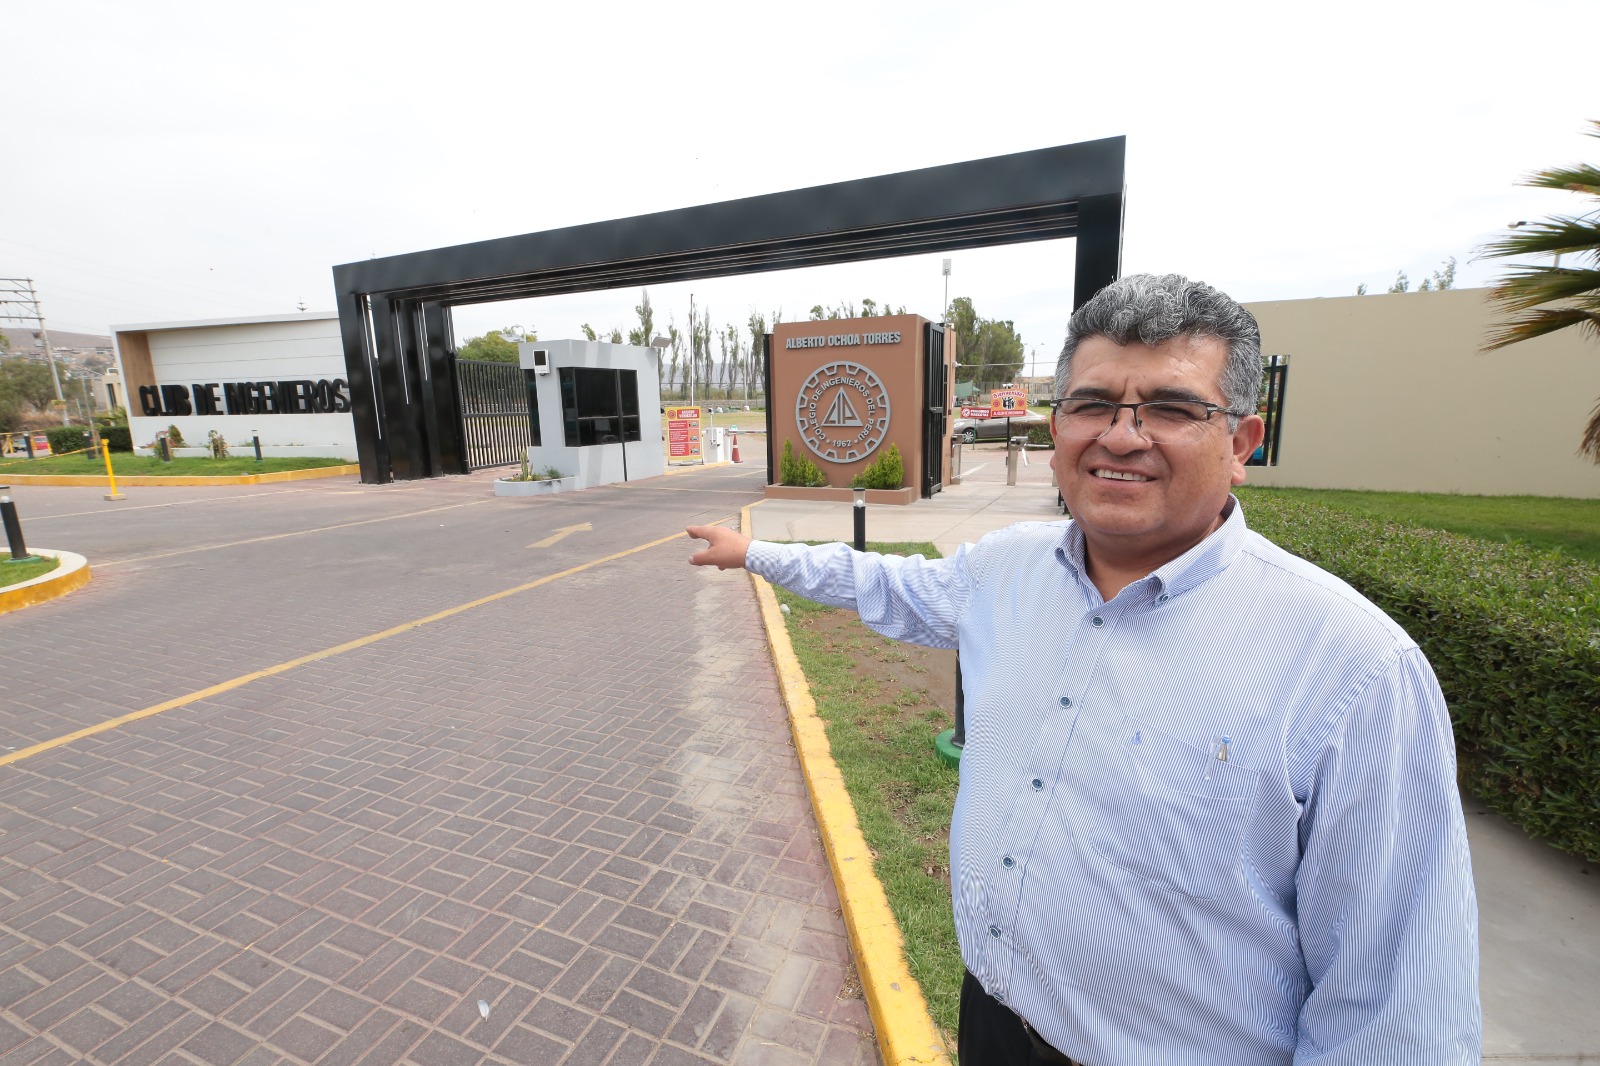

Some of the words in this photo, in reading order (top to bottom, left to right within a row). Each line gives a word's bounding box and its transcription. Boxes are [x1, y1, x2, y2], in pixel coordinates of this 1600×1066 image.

[786, 336, 825, 349] ALBERTO
[828, 334, 860, 347] OCHOA
[863, 331, 901, 345] TORRES
[138, 384, 192, 416] CLUB
[192, 383, 224, 415] DE
[223, 378, 352, 415] INGENIEROS
[812, 388, 823, 401] DE
[820, 376, 870, 397] INGENIEROS
[866, 398, 875, 416] DEL
[809, 402, 826, 440] COLEGIO
[858, 418, 874, 441] PERU
